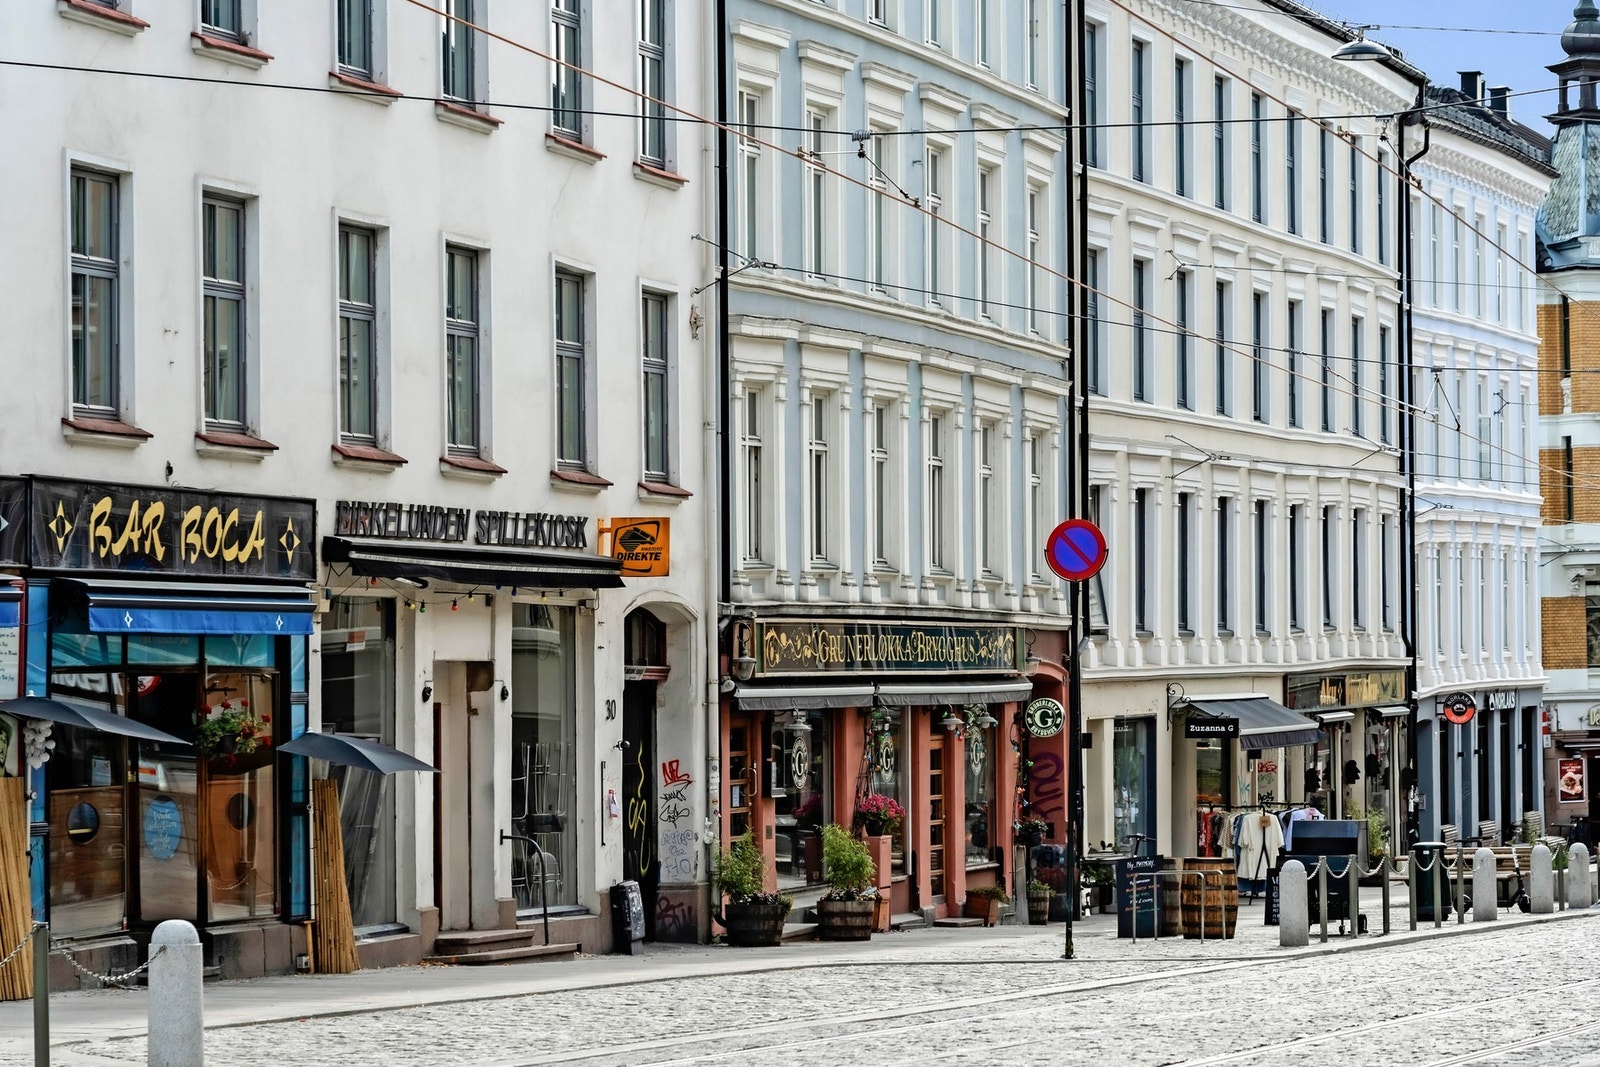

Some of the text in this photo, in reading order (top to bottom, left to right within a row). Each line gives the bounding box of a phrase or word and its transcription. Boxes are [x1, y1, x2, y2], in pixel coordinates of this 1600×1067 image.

[89, 496, 266, 564] BAR BOCA
[334, 500, 588, 548] BIRKELUNDEN SPILLEKIOSK
[616, 552, 662, 561] DIREKTE
[605, 699, 617, 721] 30
[1034, 708, 1054, 728] G
[795, 750, 804, 776] G
